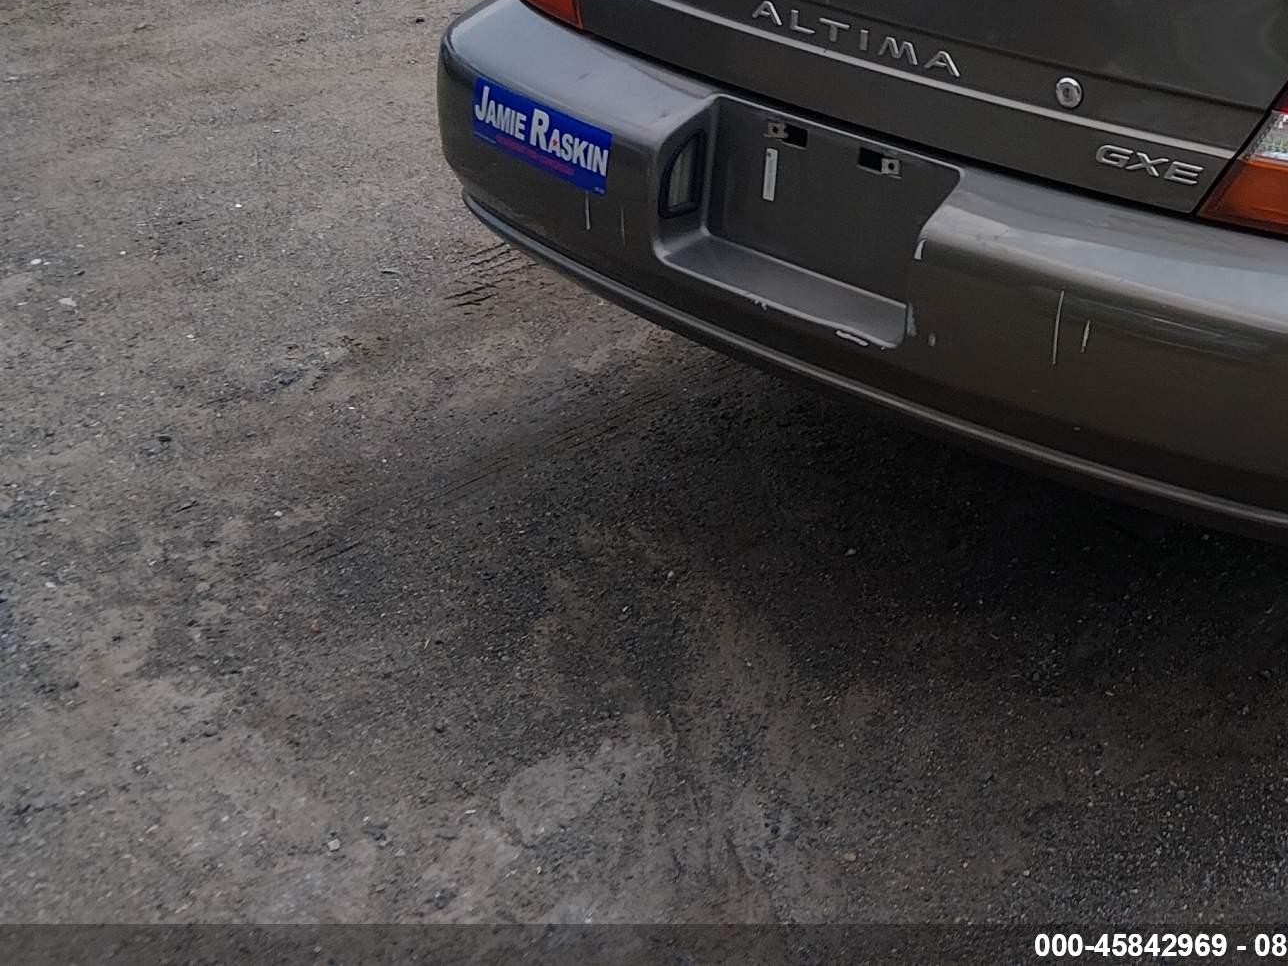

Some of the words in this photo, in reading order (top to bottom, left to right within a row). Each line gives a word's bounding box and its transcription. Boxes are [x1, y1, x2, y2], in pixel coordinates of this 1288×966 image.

[752, 0, 960, 78] ALTIMA
[474, 85, 527, 141] JAMIE
[529, 107, 609, 177] RASKIN
[1096, 144, 1204, 186] GXE
